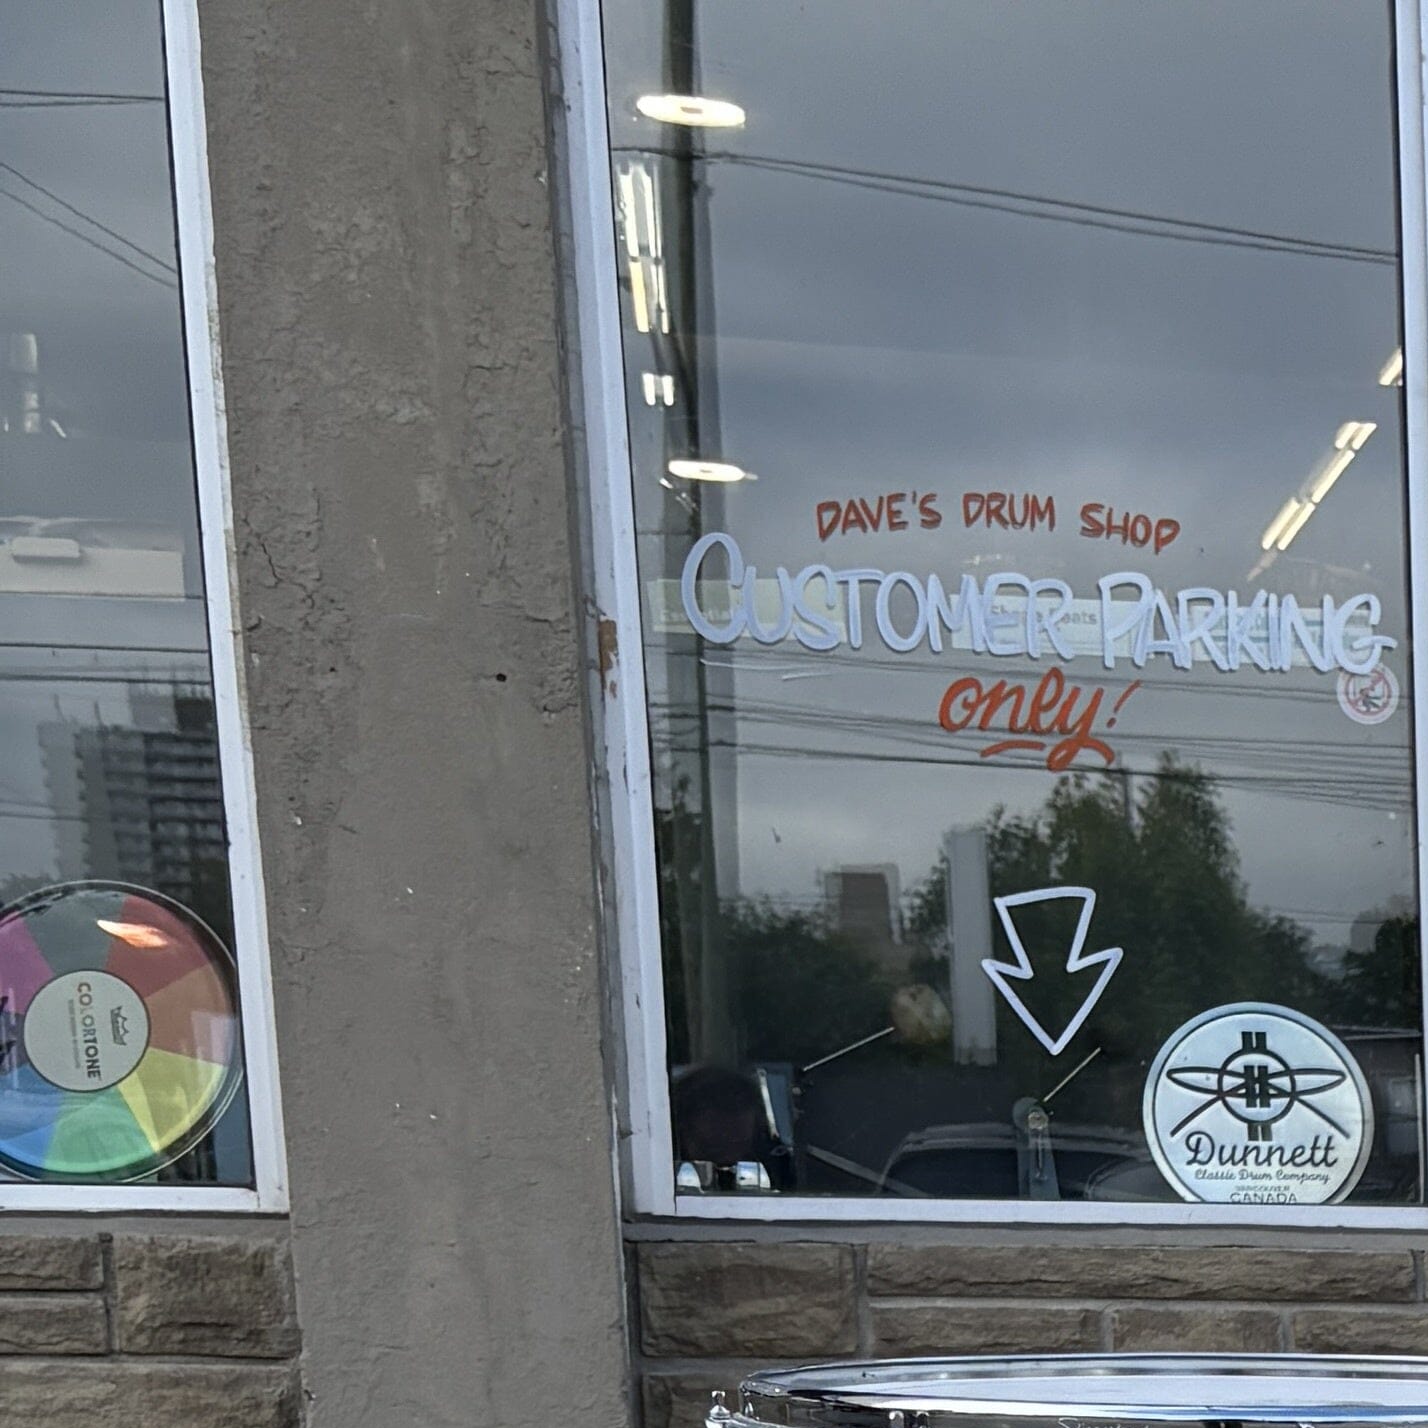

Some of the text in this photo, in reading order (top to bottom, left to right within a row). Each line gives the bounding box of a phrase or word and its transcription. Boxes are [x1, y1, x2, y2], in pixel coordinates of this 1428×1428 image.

[817, 491, 1181, 555] DAVE'S DRUM SHOP
[681, 531, 1077, 661] CUSTOMER
[1098, 571, 1398, 674] PARKING
[938, 667, 1144, 773] only!
[77, 981, 102, 1080] COLORTONE
[1184, 1130, 1339, 1168] Dunnett
[1195, 1168, 1331, 1185] Classic Drum Company
[1230, 1192, 1298, 1204] CANADA
